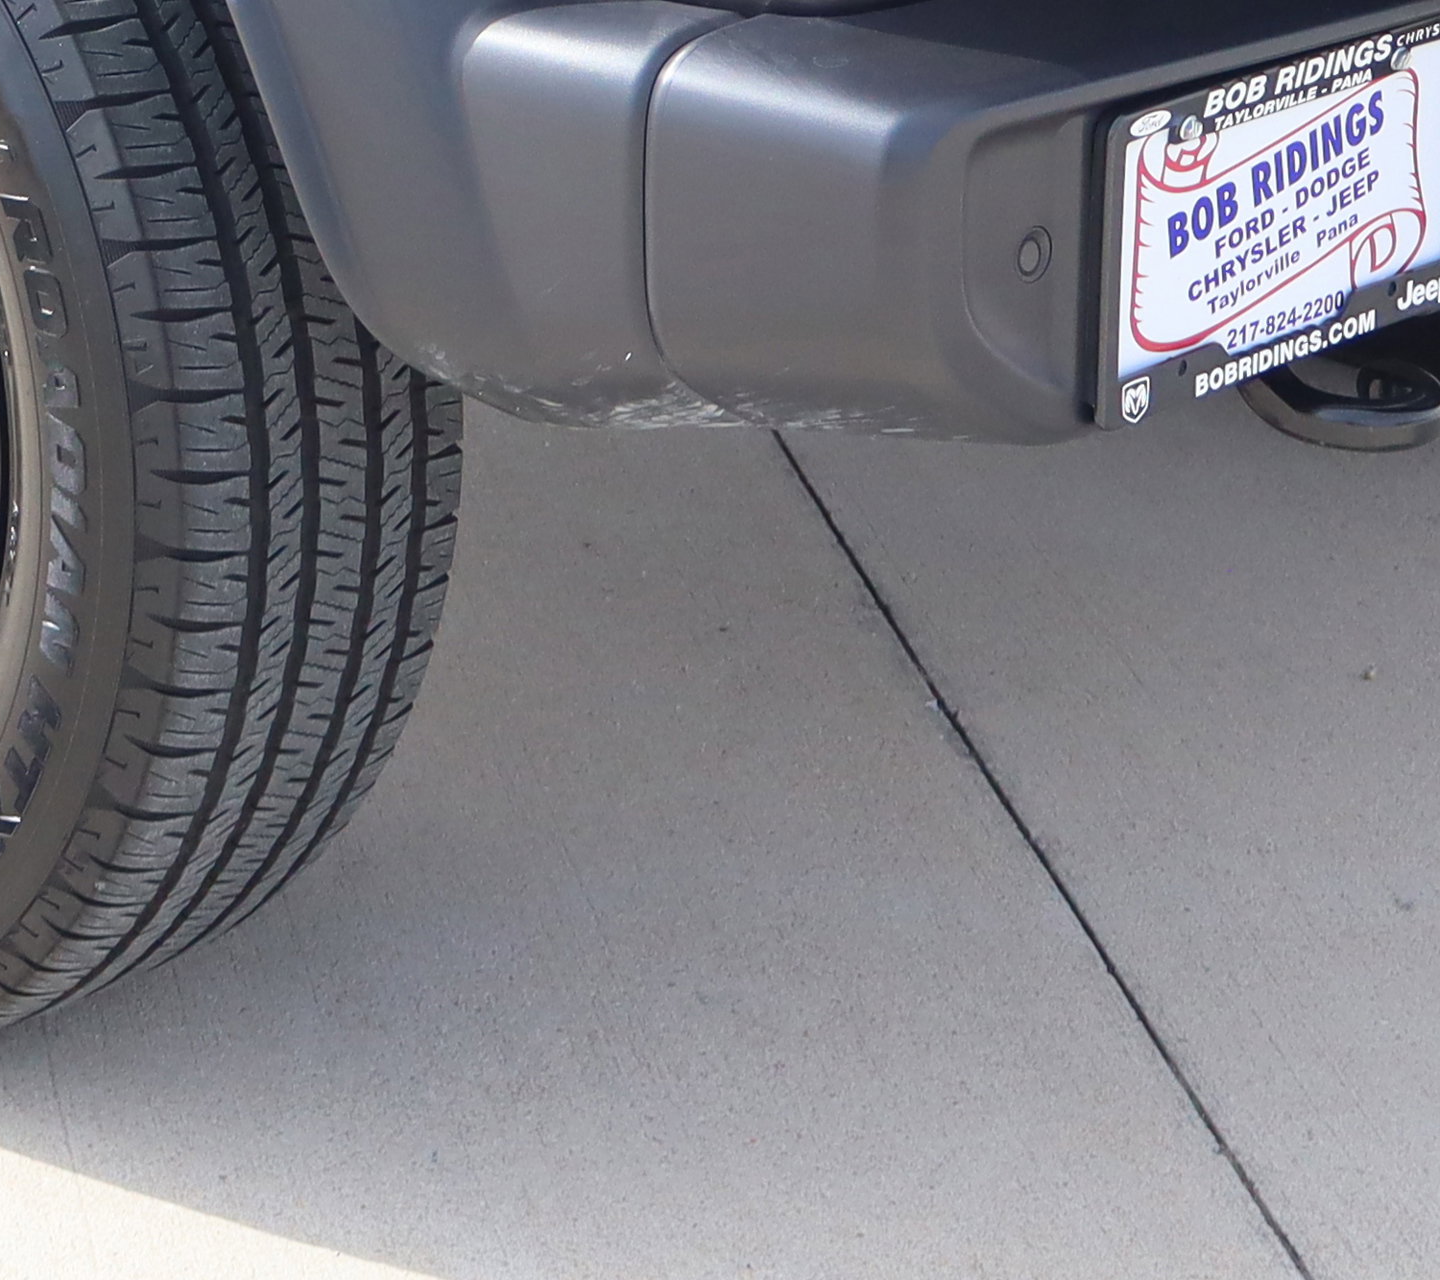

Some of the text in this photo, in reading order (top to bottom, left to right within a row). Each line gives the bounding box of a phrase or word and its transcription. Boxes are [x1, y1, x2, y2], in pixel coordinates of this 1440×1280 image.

[1203, 72, 1268, 120] BOB
[1275, 33, 1393, 95] RIDINGS
[1214, 85, 1317, 133] TAYLORVILLE
[1331, 68, 1373, 96] PANA
[1166, 90, 1385, 260] BOB RIDINGS
[1214, 211, 1275, 258] FORD
[1294, 147, 1372, 214] DODGE
[1187, 219, 1308, 303] CHRYSLER
[1326, 168, 1380, 219] JEEP
[1207, 211, 1359, 316] Taylorville Pana
[1195, 308, 1376, 399] BOBRIDINGS.COM
[1226, 290, 1345, 351] 217-824-2200
